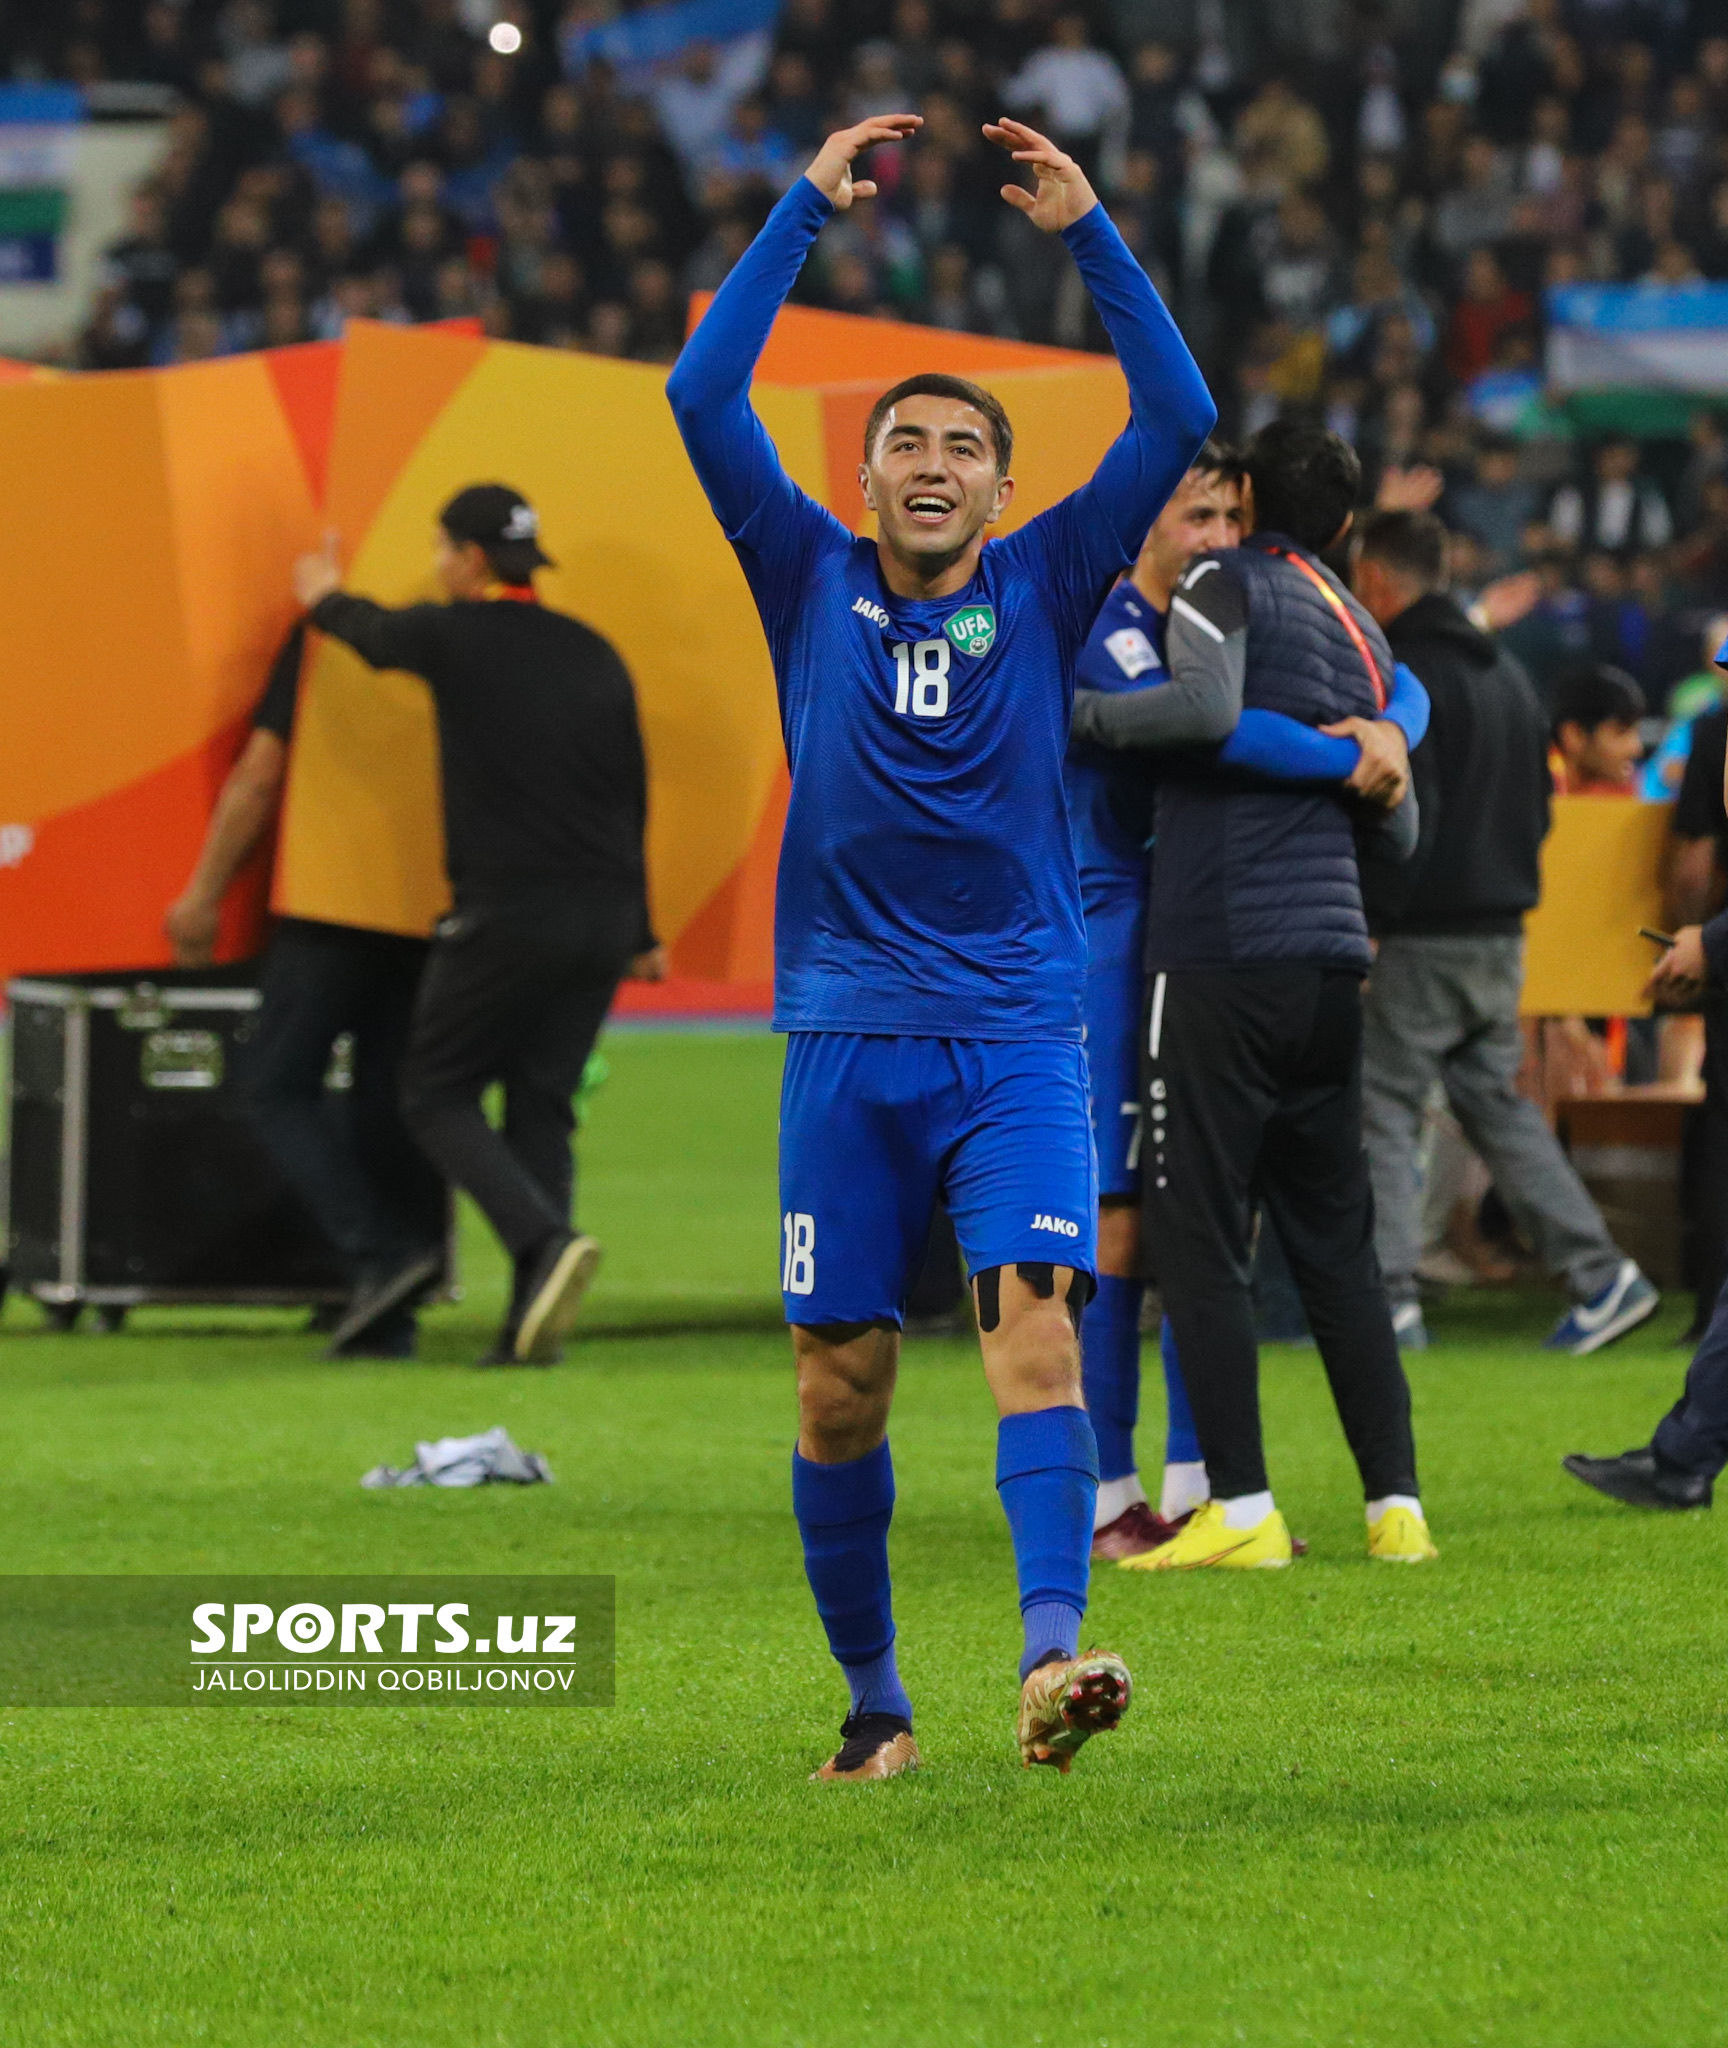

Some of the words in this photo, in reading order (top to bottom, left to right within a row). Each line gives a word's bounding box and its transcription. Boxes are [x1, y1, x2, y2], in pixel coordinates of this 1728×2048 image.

[851, 596, 890, 628] JAKO
[951, 613, 990, 641] UFA
[892, 639, 951, 717] 18
[1030, 1213, 1079, 1238] JAKO
[782, 1211, 815, 1296] 18
